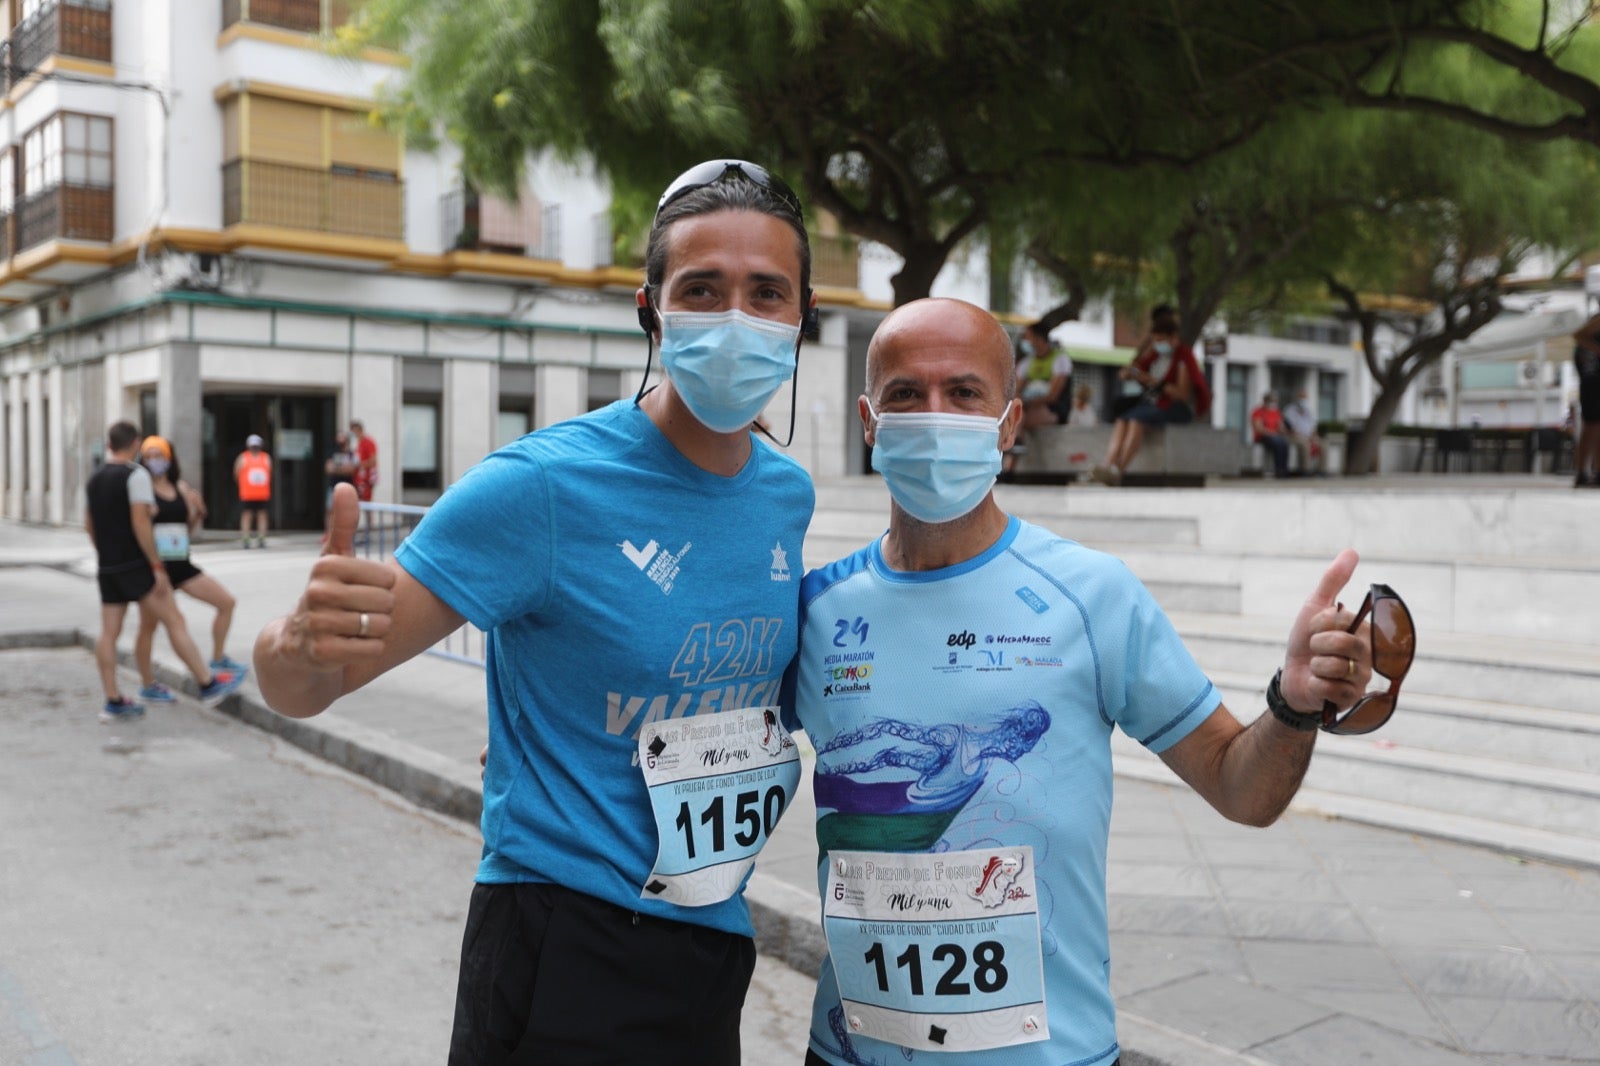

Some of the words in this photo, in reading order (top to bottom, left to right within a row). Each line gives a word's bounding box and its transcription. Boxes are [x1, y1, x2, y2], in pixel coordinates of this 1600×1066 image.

[947, 630, 976, 650] edp
[669, 617, 783, 687] 42K
[824, 654, 842, 665] MEDIA
[844, 649, 875, 663] MARATÓN
[834, 682, 871, 692] CaixaBank
[700, 748, 726, 767] Mil
[682, 782, 706, 794] PRUEBA
[707, 780, 715, 791] DE
[715, 777, 735, 790] FONDO
[757, 772, 764, 782] DE
[675, 785, 786, 860] 1150
[866, 861, 911, 881] PREMIO
[913, 868, 930, 881] DE
[886, 893, 914, 912] Mil
[924, 896, 954, 911] una
[868, 924, 896, 936] PRUEBA
[897, 924, 907, 936] DE
[907, 924, 932, 936] FONDO
[966, 923, 977, 935] DE
[864, 940, 1009, 996] 1128
